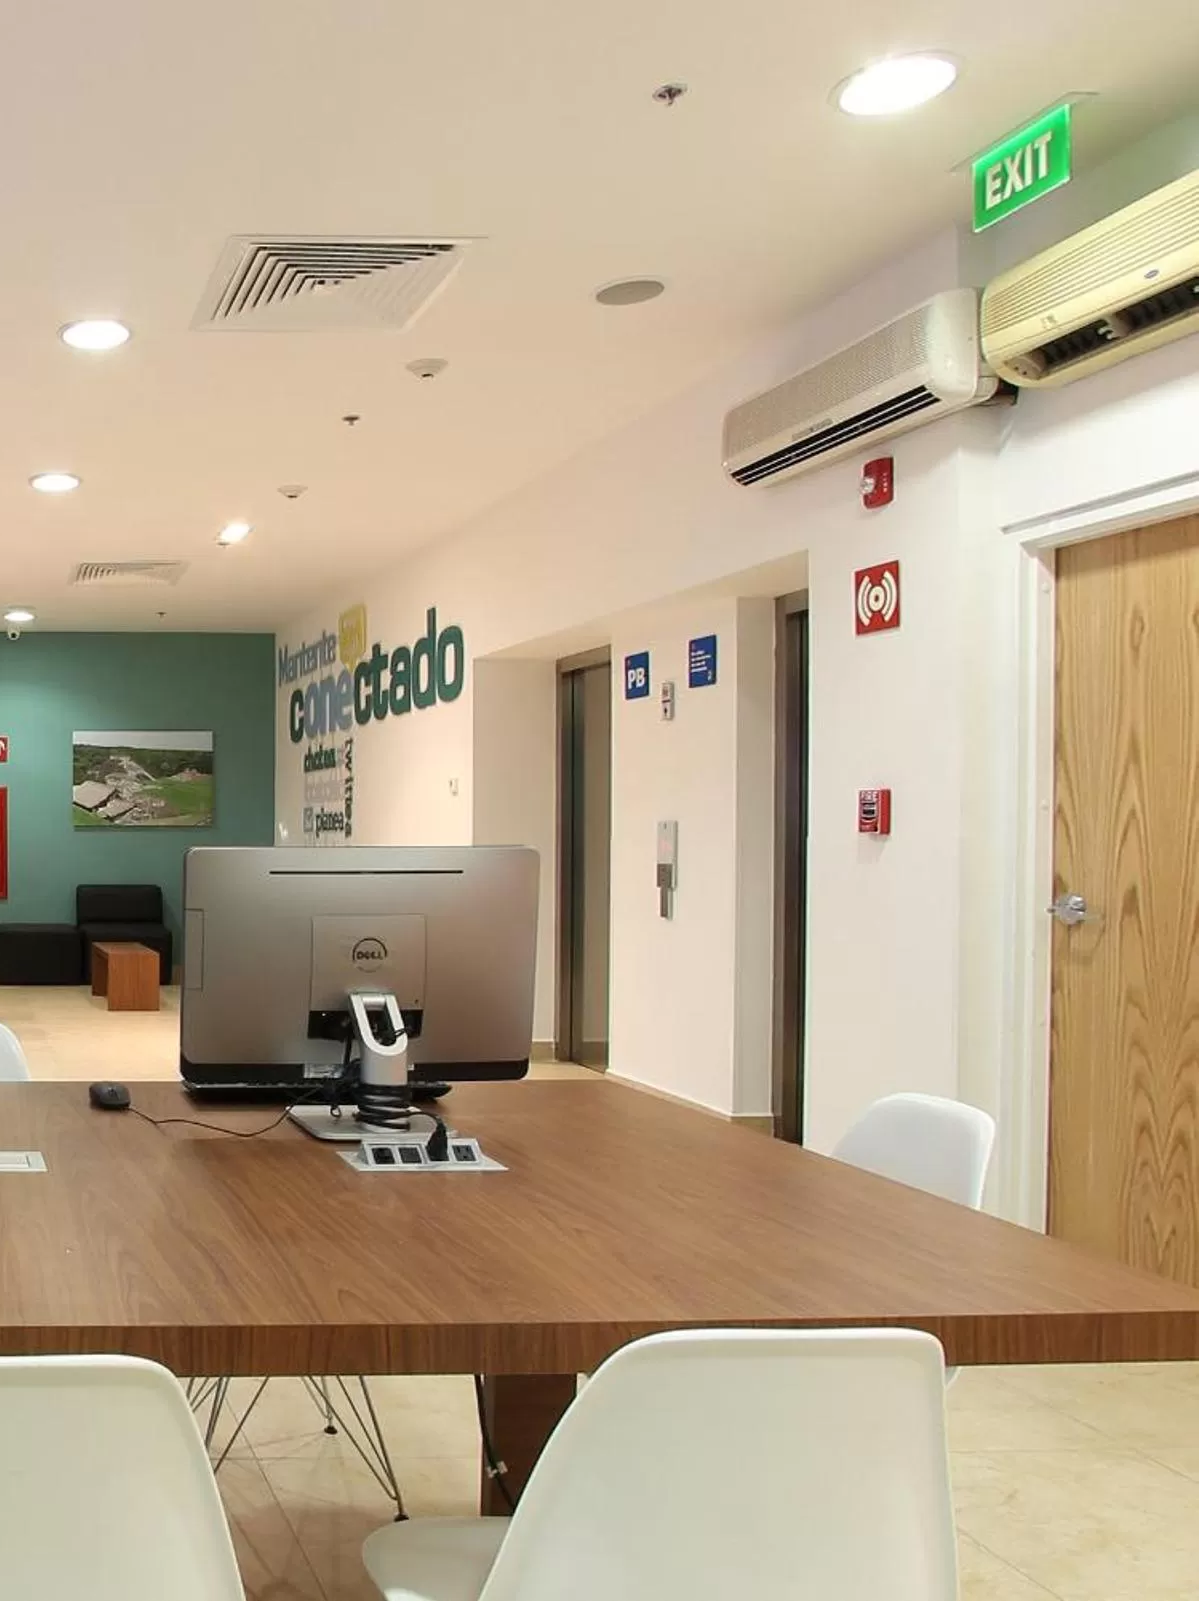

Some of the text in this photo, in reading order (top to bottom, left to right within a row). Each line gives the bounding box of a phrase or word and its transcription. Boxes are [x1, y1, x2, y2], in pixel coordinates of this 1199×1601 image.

[985, 131, 1052, 210] EXIT
[290, 606, 464, 743] conectado
[627, 667, 645, 689] PB
[357, 950, 383, 961] DELL
